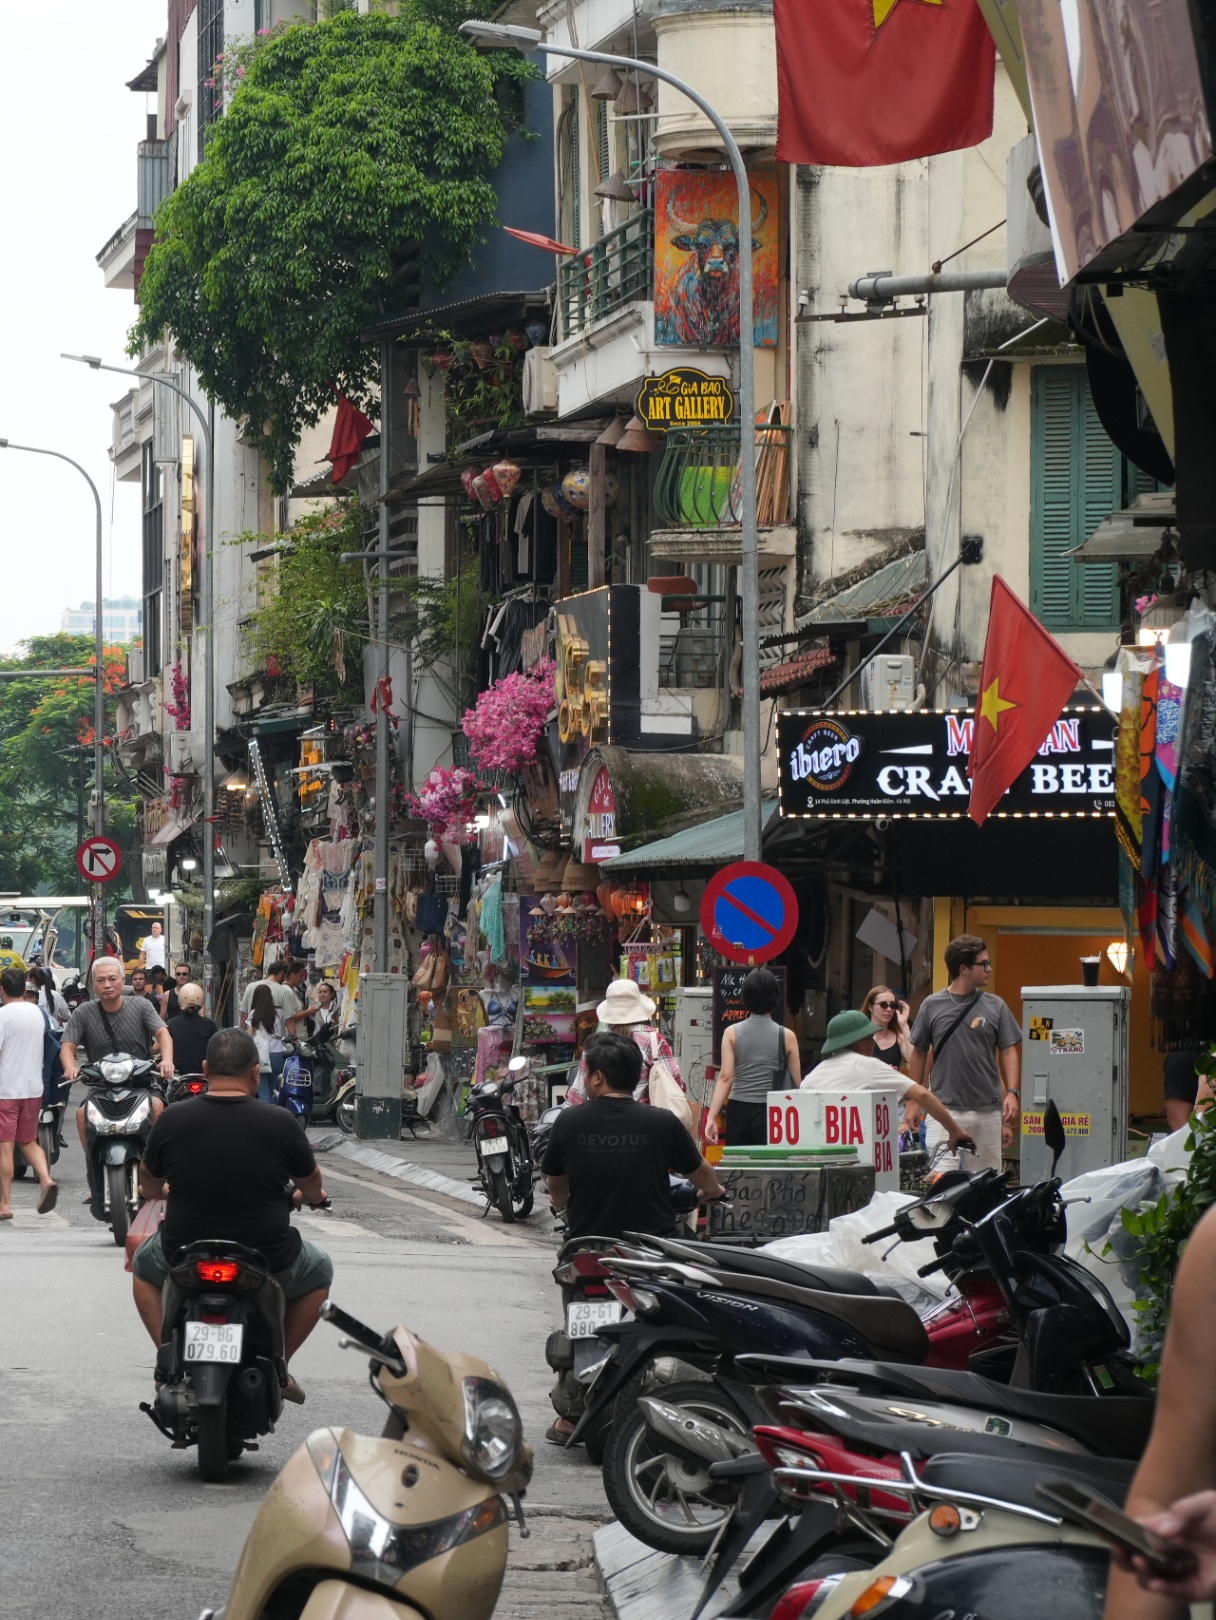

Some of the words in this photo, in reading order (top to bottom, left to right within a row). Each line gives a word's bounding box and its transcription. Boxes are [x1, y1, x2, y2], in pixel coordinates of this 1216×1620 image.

[648, 396, 672, 420] ART
[674, 396, 725, 420] GALLERY
[823, 729, 839, 742] BEER
[1031, 764, 1116, 794] BEE
[768, 1095, 800, 1146] BÒ
[825, 1095, 865, 1146] BÍA
[875, 1096, 890, 1136] BÒ
[576, 1134, 649, 1147] DEVOTUS
[874, 1134, 893, 1173] BÍA
[696, 1291, 759, 1311] VISION
[575, 1304, 612, 1320] 29-G1
[192, 1326, 234, 1343] 29-BG
[187, 1343, 238, 1361] 079.60
[394, 1449, 441, 1472] HONDA
